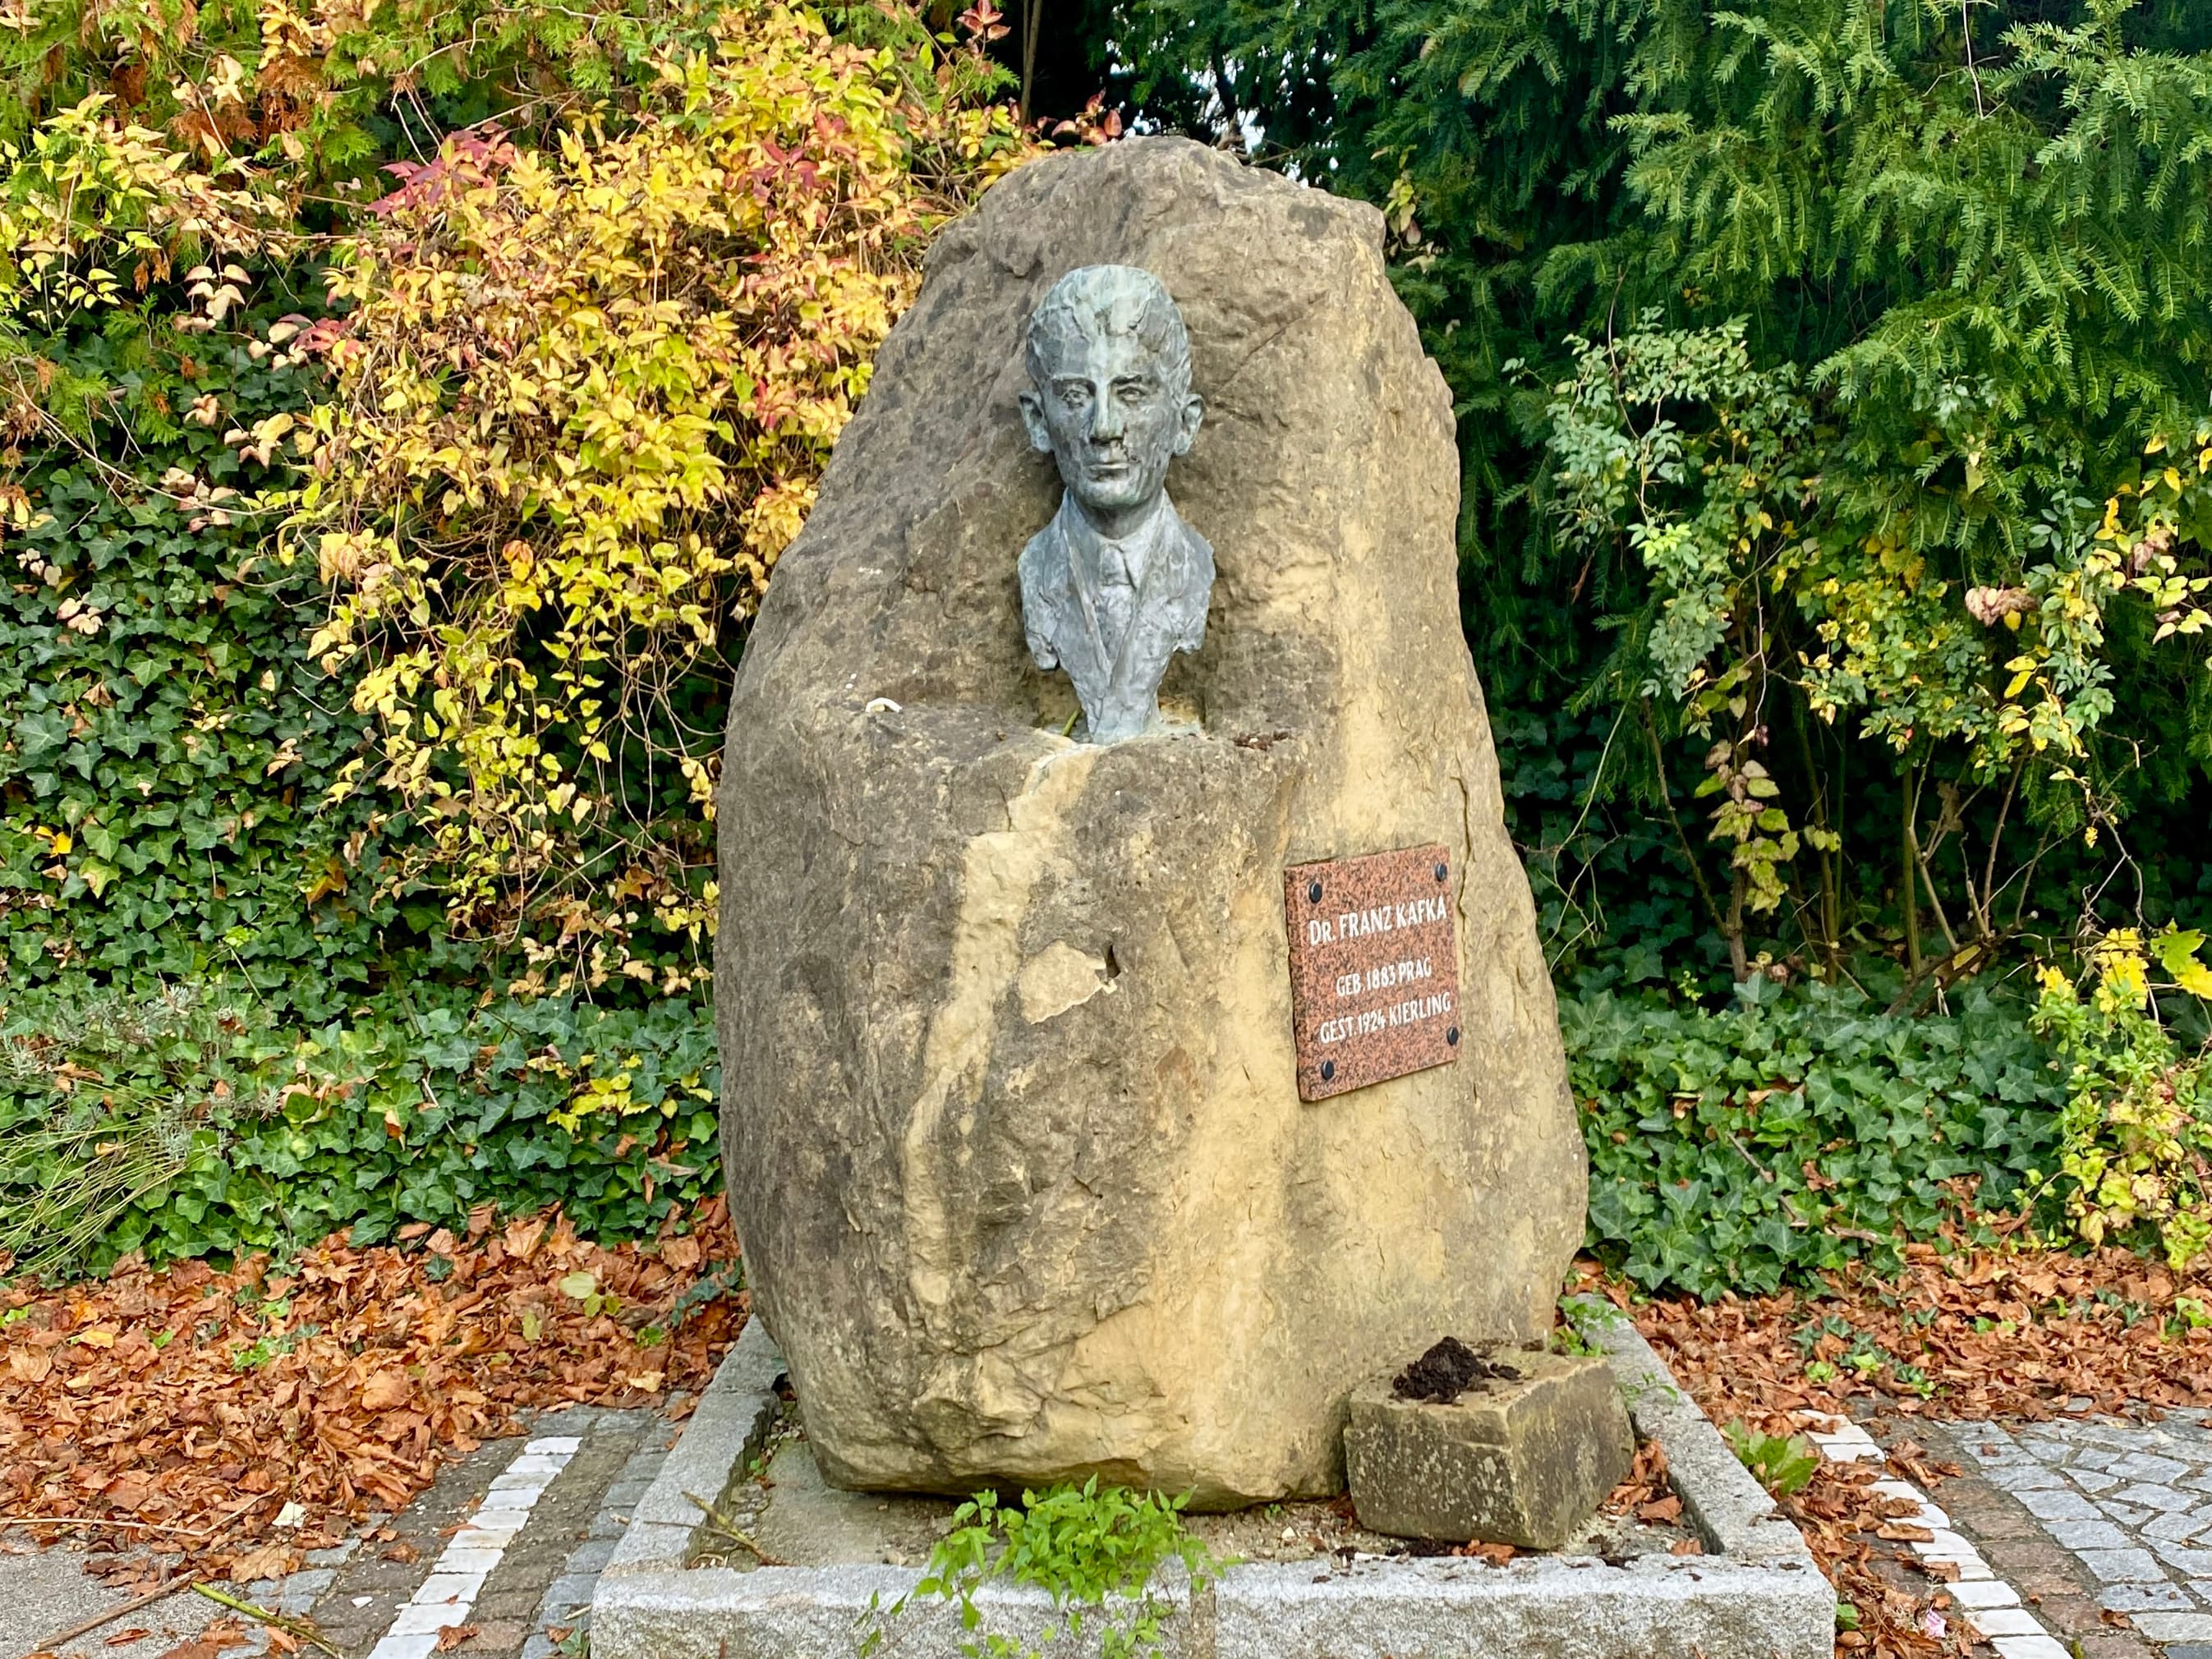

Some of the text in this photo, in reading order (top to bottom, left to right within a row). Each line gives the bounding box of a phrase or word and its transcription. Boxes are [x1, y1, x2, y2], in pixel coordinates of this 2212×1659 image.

[1309, 894, 1447, 946] DR. FRANZ KAFKA
[1366, 965, 1396, 990] 1883
[1398, 957, 1433, 984] PRAG
[1389, 991, 1451, 1027] KIERLING
